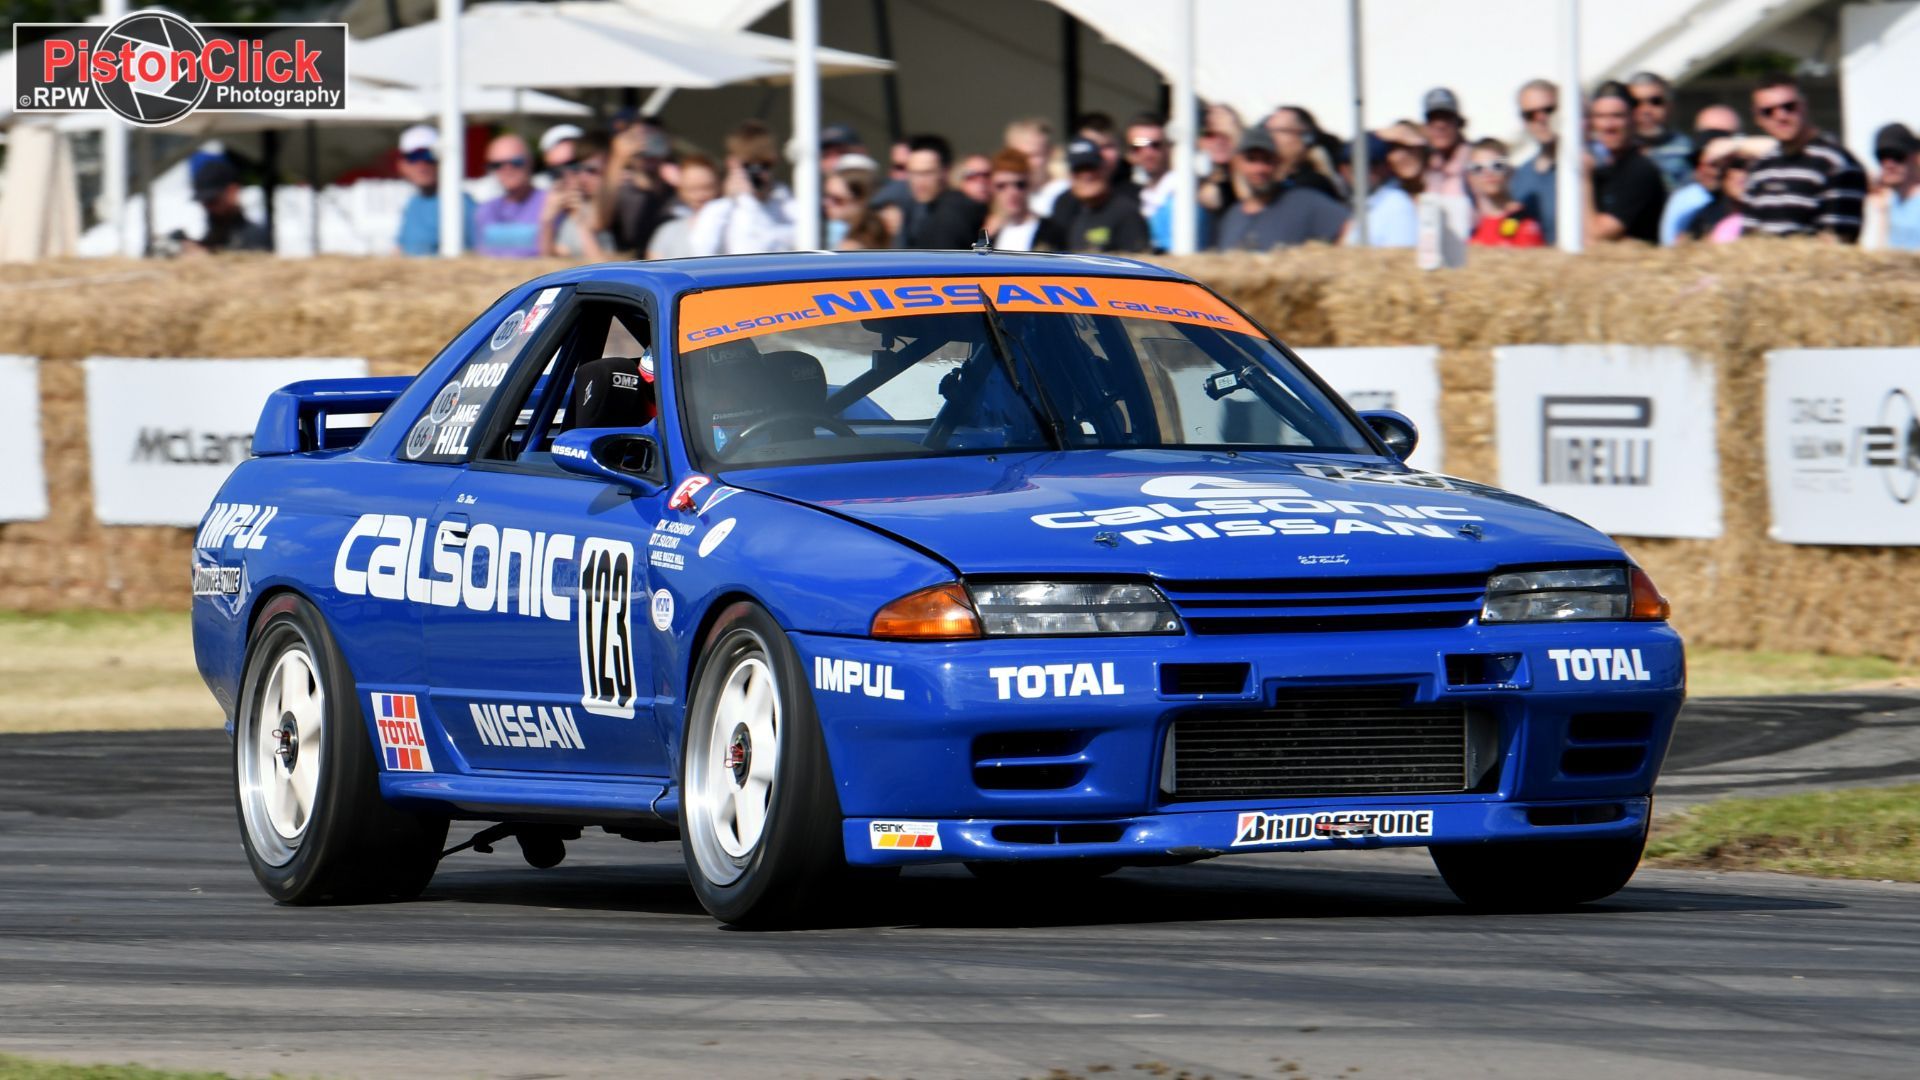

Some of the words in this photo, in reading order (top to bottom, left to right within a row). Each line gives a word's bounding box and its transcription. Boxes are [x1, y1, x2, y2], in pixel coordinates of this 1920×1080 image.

[812, 284, 1098, 317] NISSAN
[461, 363, 510, 388] WOOD
[613, 374, 638, 387] OMP
[451, 404, 481, 423] JAKE
[132, 425, 253, 465] McLar
[433, 425, 472, 455] HILL
[551, 445, 588, 459] NISSAN
[1541, 395, 1653, 486] PIRELLI
[196, 503, 279, 550] IMPUL
[1120, 518, 1455, 545] NISSAN
[582, 548, 633, 708] 123
[814, 656, 905, 701] IMPUL
[989, 662, 1125, 700] TOTAL
[1547, 648, 1651, 682] TOTAL
[378, 719, 425, 747] TOTAL
[469, 703, 586, 750] NISSAN
